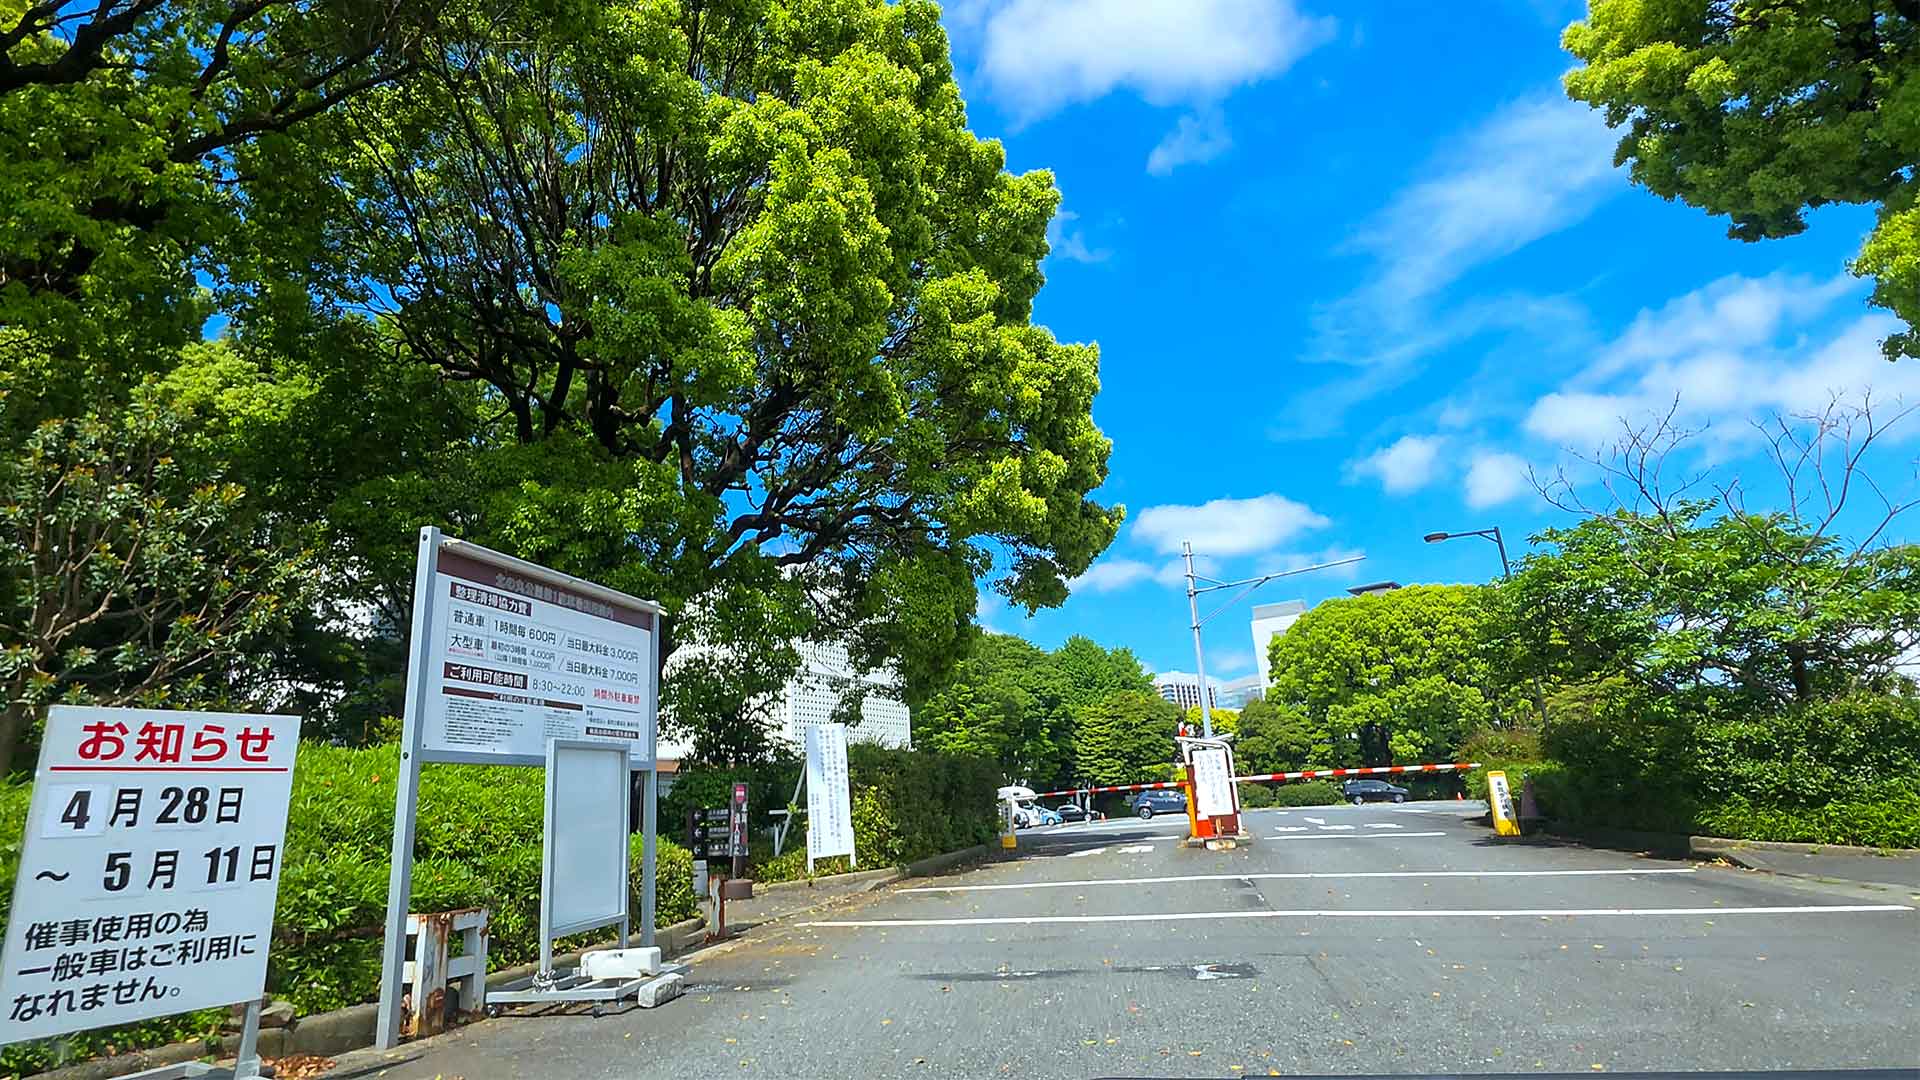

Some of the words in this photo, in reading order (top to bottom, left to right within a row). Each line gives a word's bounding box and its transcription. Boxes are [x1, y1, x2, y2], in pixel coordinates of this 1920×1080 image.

[455, 584, 529, 614] 整理清掃協力費
[454, 609, 486, 627] 普通車
[494, 619, 527, 639] 1時間毎
[529, 628, 556, 645] 600円
[451, 633, 485, 651] 大型車
[449, 664, 525, 689] ご利用可能時間
[77, 720, 275, 763] お知らせ
[25, 908, 209, 952] 催事使用の為
[17, 934, 257, 983] 一般車はご利用に
[9, 975, 181, 1022] なれません。
